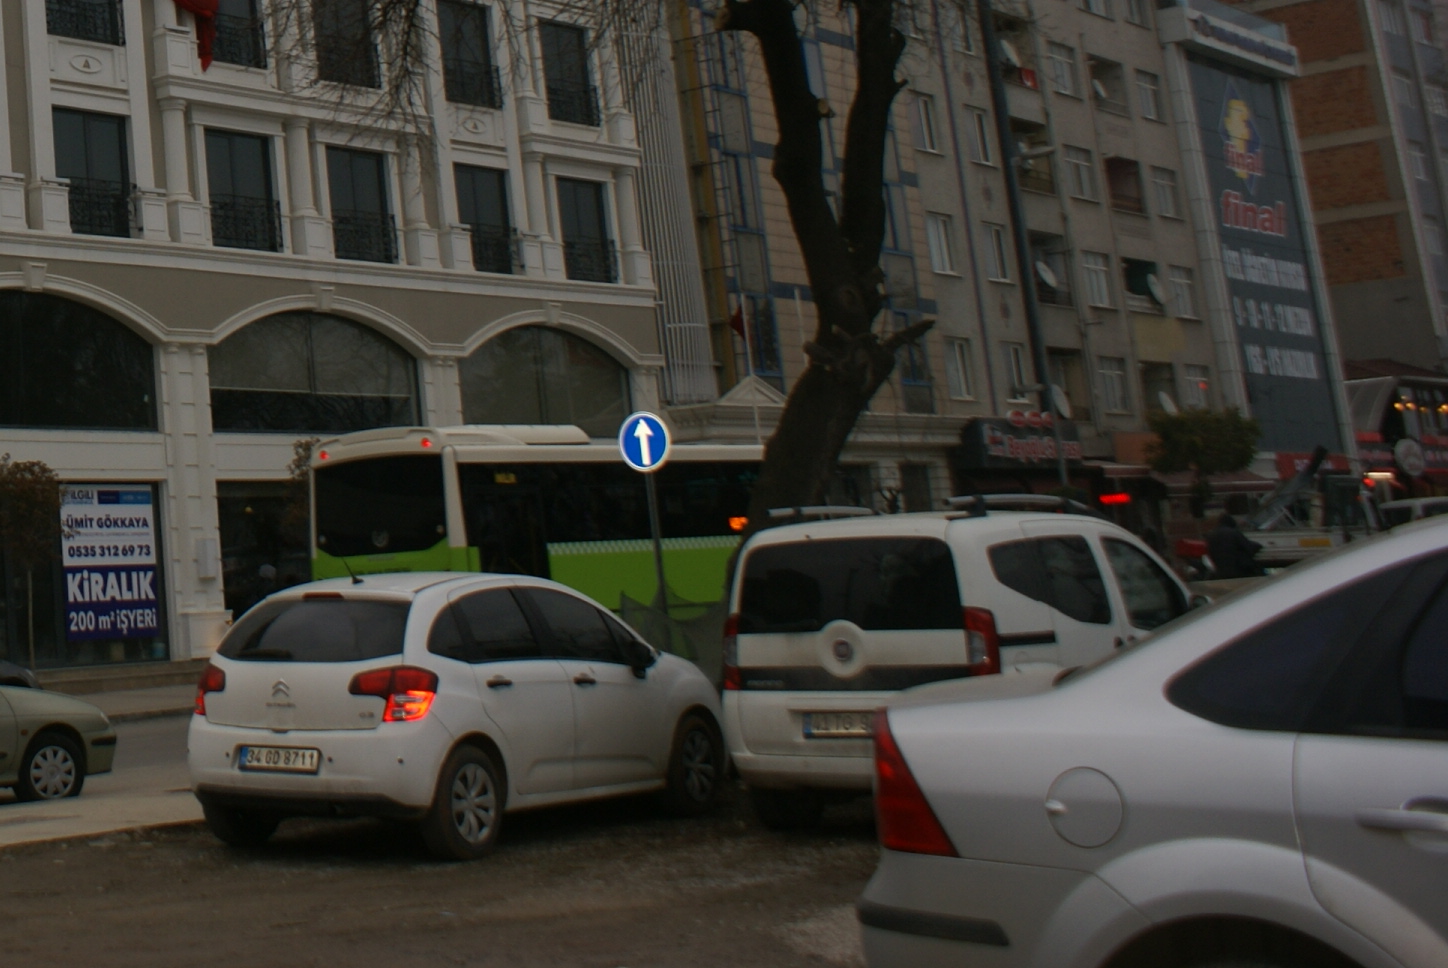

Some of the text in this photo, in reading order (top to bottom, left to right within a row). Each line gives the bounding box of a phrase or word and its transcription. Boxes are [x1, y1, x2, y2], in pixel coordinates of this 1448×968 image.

[1220, 189, 1286, 237] final
[66, 514, 149, 529] ÜMİT GÖKKAYA
[68, 544, 151, 557] 0535 312 69 73
[70, 610, 95, 631] 200
[247, 749, 315, 766] 34 GD 8711
